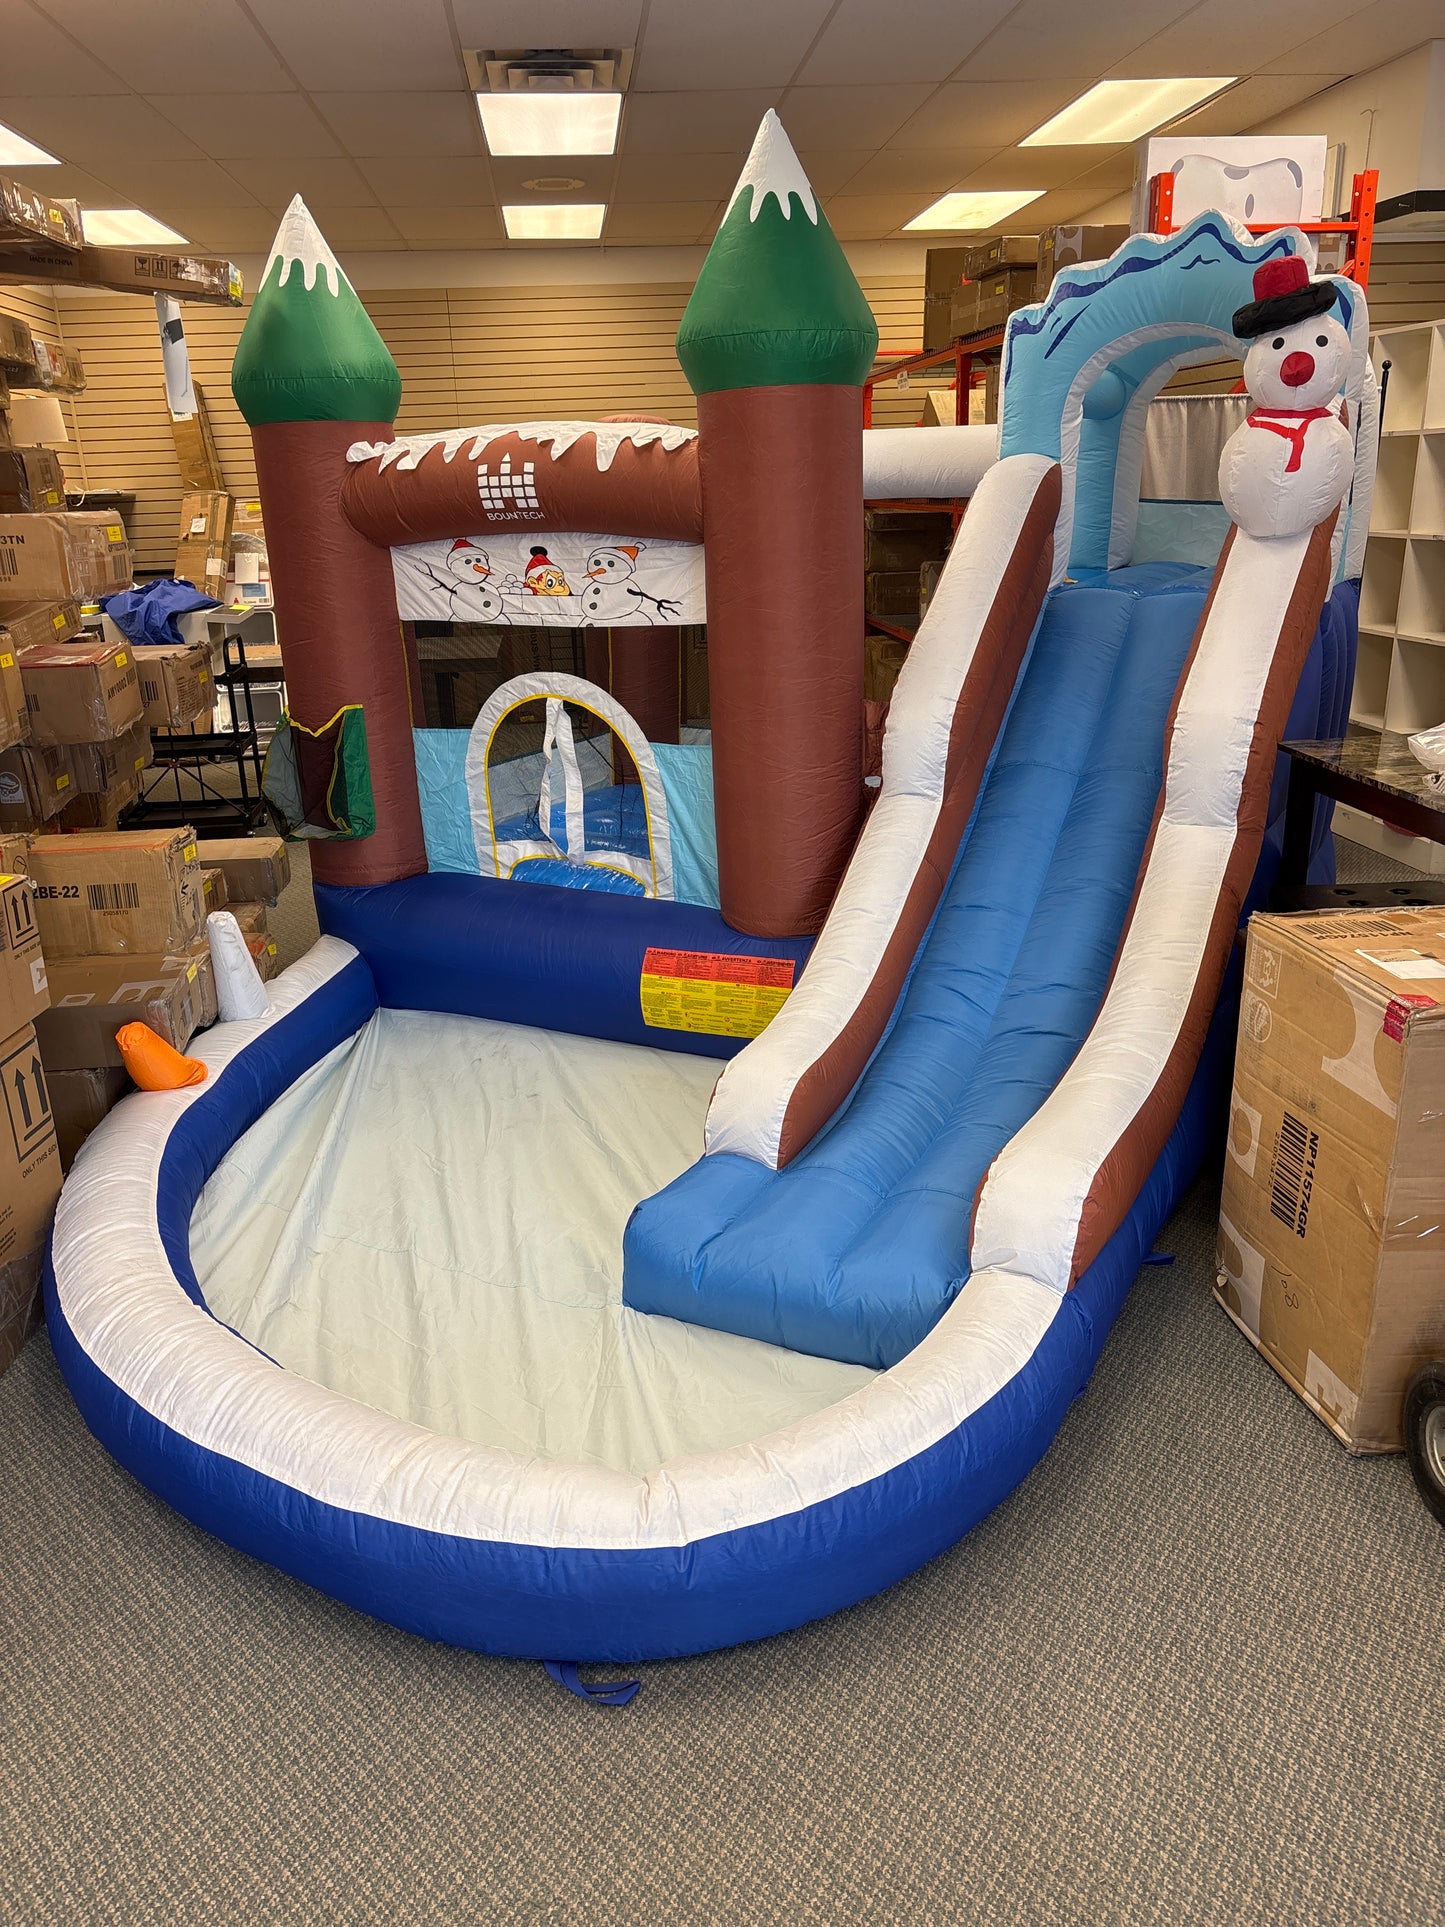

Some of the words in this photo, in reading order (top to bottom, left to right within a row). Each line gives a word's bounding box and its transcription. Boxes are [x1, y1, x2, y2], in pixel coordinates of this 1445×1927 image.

[29, 255, 46, 264] MADE
[55, 258, 73, 266] CHINA
[486, 511, 546, 521] BOUNTECH
[1314, 931, 1414, 941] NP11574GR
[22, 1160, 37, 1179] ONLY
[36, 1150, 48, 1166] THIS
[1296, 1131, 1320, 1240] NP11574GR
